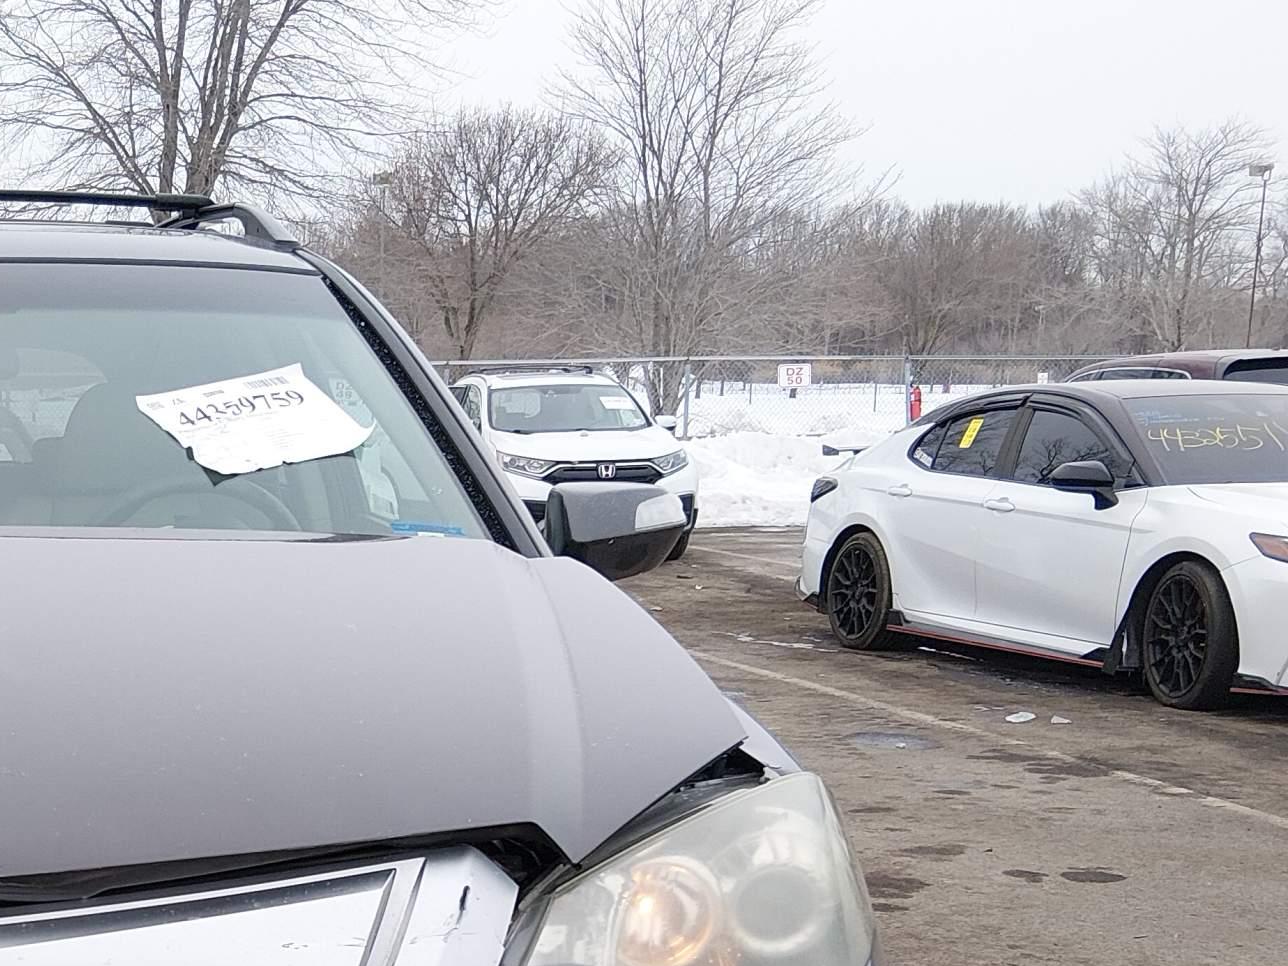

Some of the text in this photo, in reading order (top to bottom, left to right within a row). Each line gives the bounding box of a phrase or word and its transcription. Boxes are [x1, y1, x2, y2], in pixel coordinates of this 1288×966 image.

[785, 367, 804, 376] DZ
[786, 376, 803, 385] 50
[178, 389, 305, 426] 44359759
